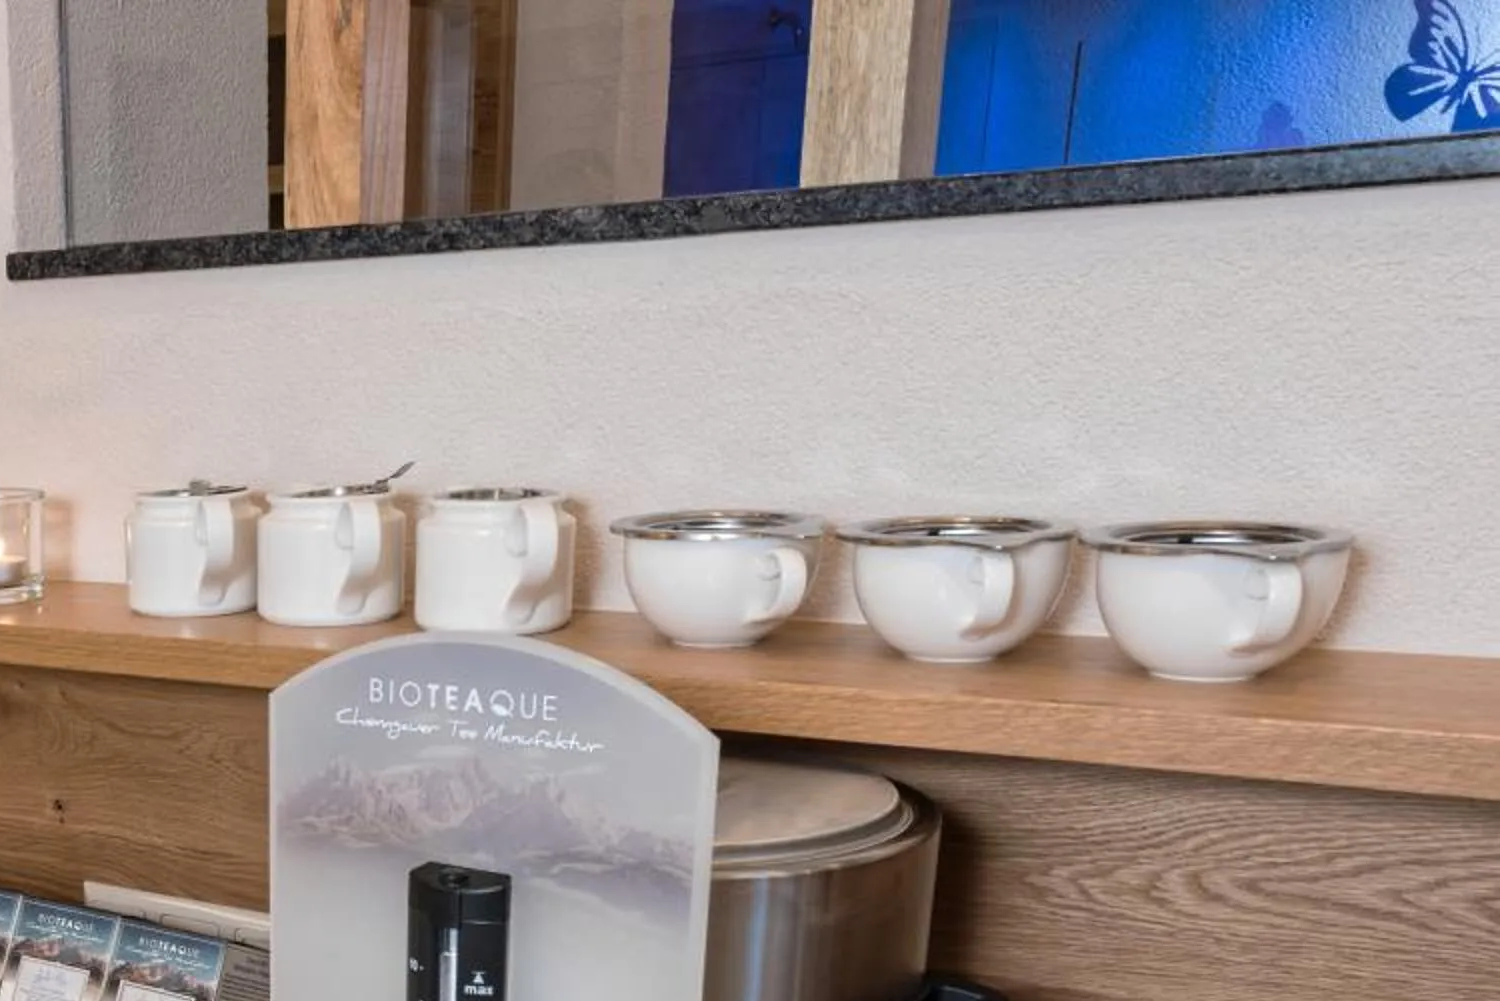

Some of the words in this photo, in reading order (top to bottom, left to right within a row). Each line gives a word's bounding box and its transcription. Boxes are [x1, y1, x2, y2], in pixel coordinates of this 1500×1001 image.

[369, 677, 559, 722] BIOTEAQUE
[483, 721, 604, 753] Manufaktur
[463, 984, 494, 996] max
